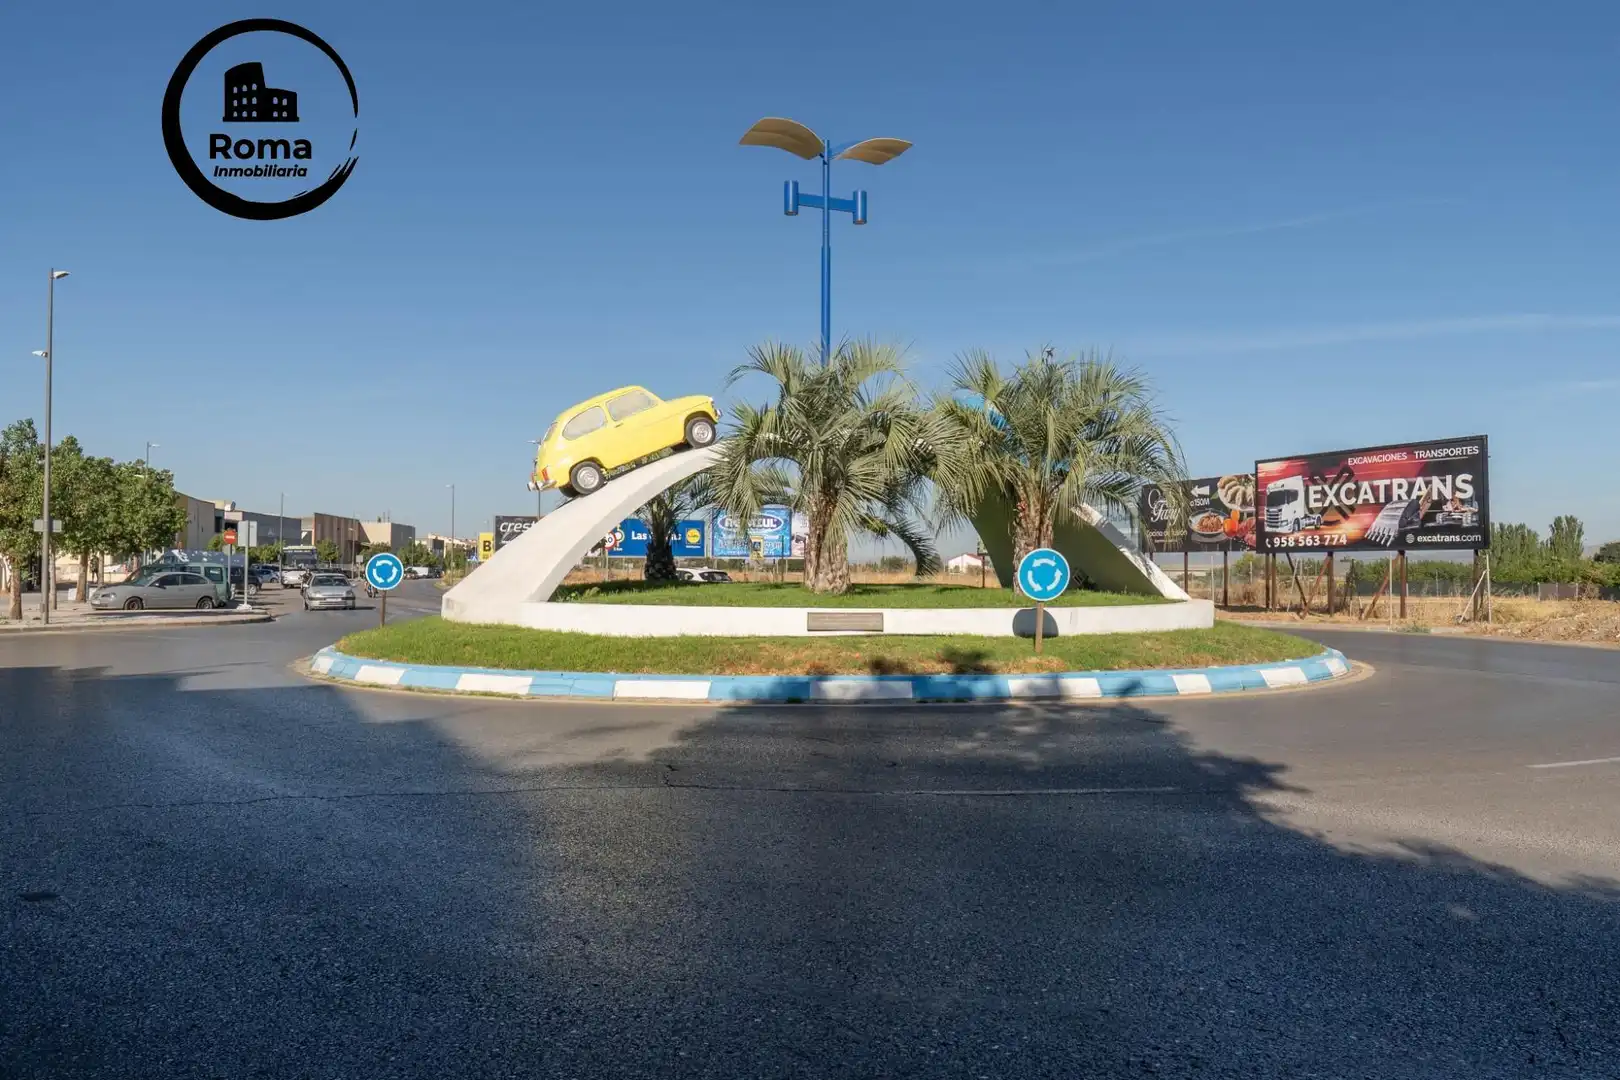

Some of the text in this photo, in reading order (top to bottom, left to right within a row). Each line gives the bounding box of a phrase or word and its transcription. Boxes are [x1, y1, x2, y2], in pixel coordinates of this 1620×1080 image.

[1347, 446, 1479, 466] EXCAVACIONES TRANSPORTES
[1308, 473, 1474, 508] EXCATRANS
[631, 530, 647, 540] Las
[1273, 533, 1348, 548] 958 563 774
[1416, 533, 1482, 543] excatrans.com
[483, 540, 492, 552] B
